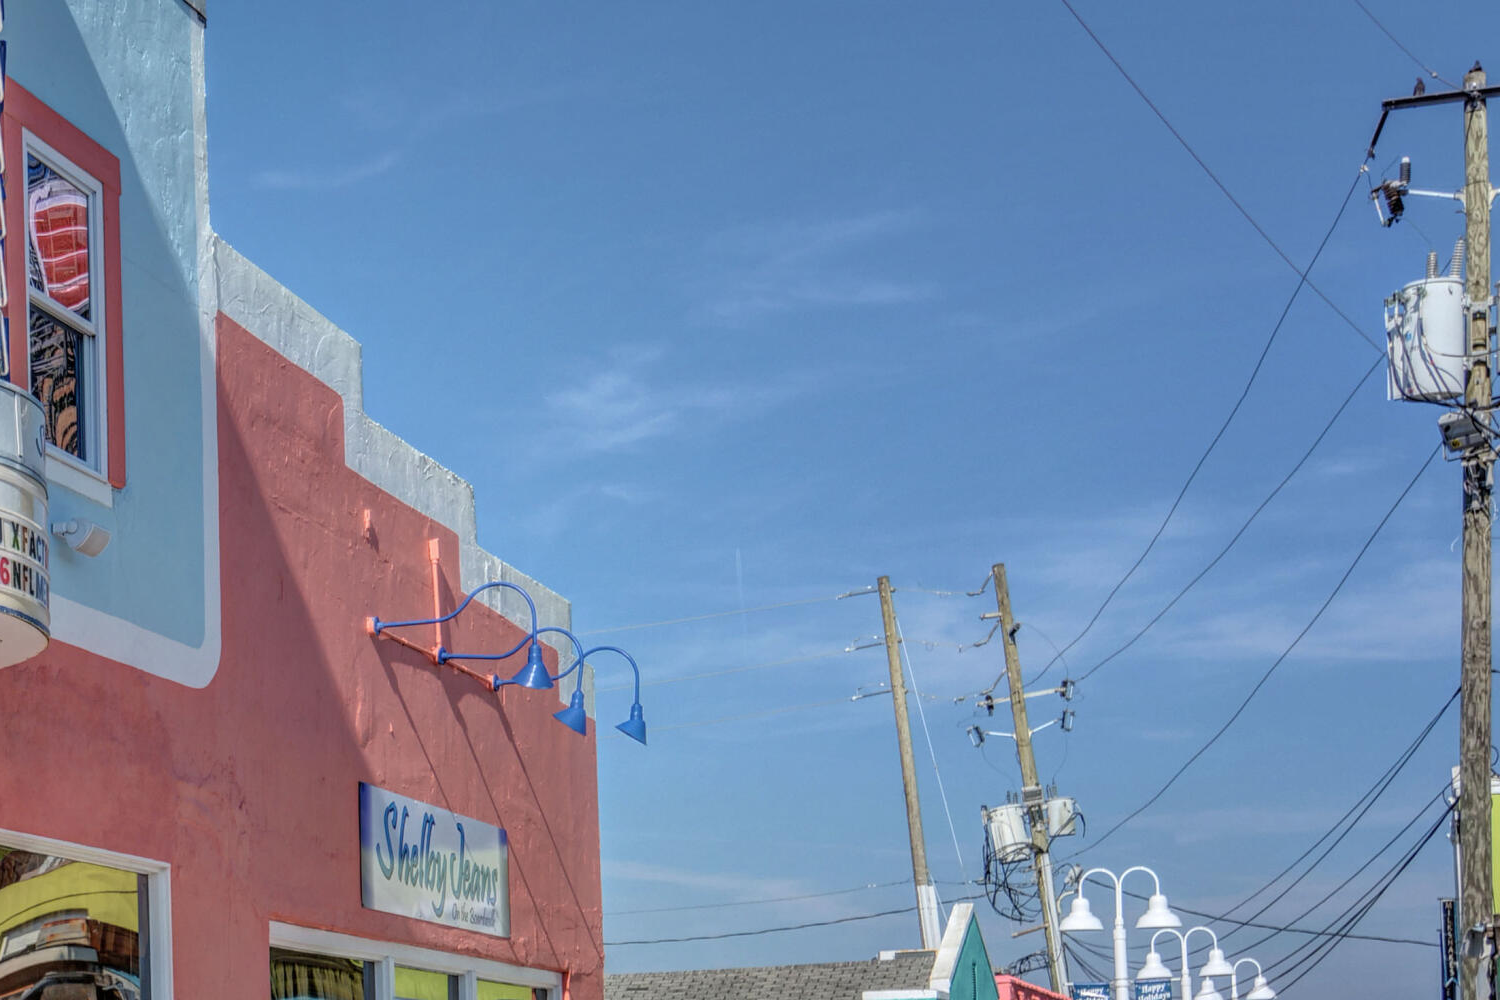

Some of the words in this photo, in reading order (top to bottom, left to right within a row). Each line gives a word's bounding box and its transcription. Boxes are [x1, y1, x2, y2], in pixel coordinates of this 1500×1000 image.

[376, 800, 448, 918] Shelby
[450, 822, 499, 907] Jeans
[1141, 983, 1165, 994] Happy
